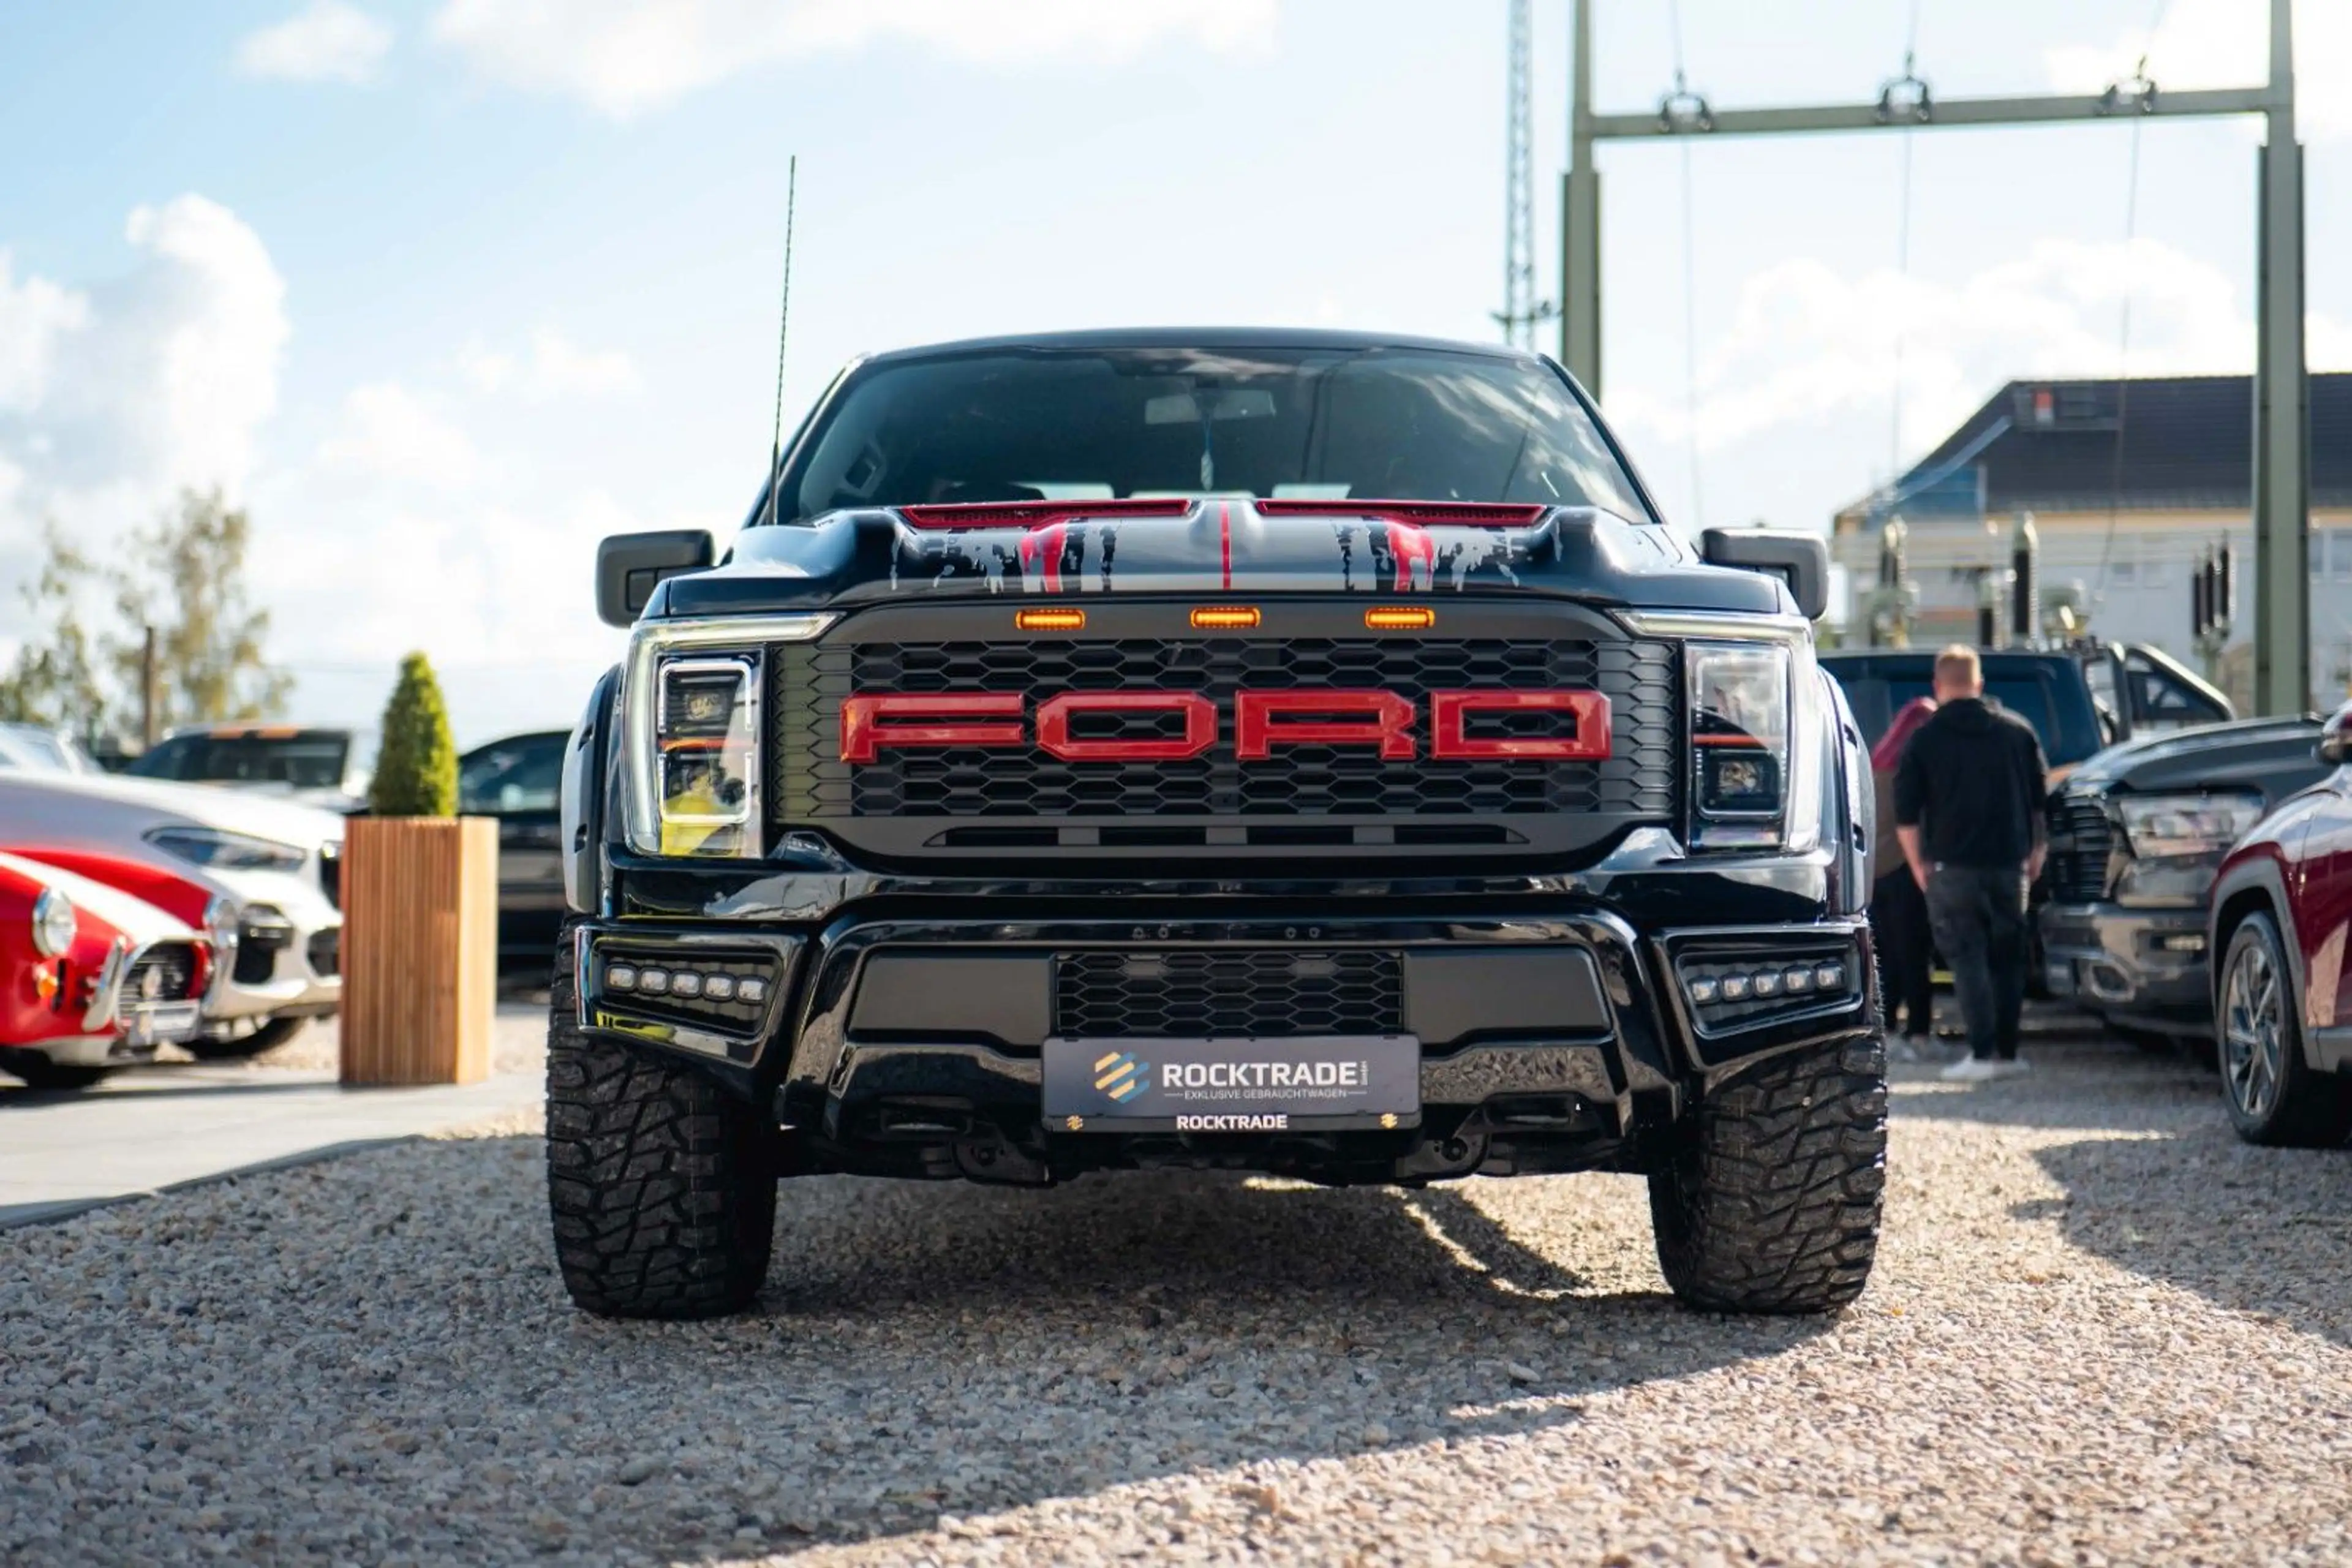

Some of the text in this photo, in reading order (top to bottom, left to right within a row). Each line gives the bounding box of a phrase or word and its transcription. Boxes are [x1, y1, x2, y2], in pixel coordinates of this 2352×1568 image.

[840, 690, 1612, 763] FORD
[1163, 1062, 1358, 1087] ROCKTRADE
[1185, 1089, 1241, 1100] EXKLUSIVE
[1177, 1115, 1287, 1129] ROCKTRADE
